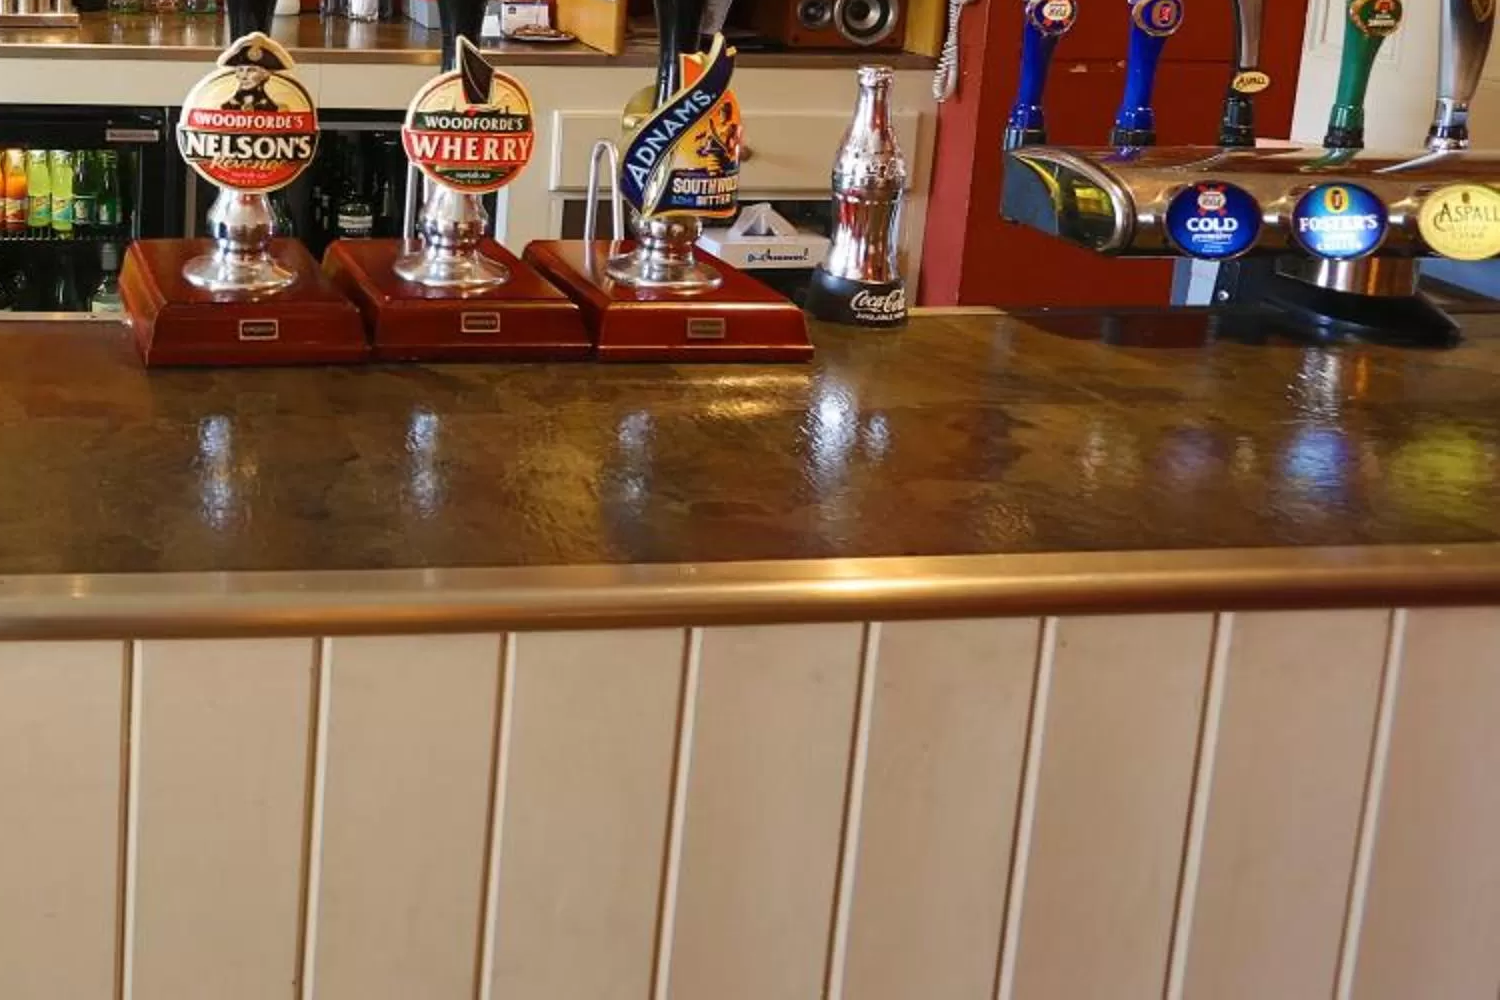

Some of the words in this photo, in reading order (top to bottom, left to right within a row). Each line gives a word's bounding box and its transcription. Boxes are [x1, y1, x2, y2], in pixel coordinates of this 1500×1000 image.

[193, 112, 303, 129] WOODFORDE'S
[424, 115, 523, 131] WOODFORDE'S
[186, 131, 311, 161] NELSON'S
[410, 133, 532, 161] WHERRY
[627, 90, 712, 191] ADNAMS
[1186, 217, 1239, 232] COLD
